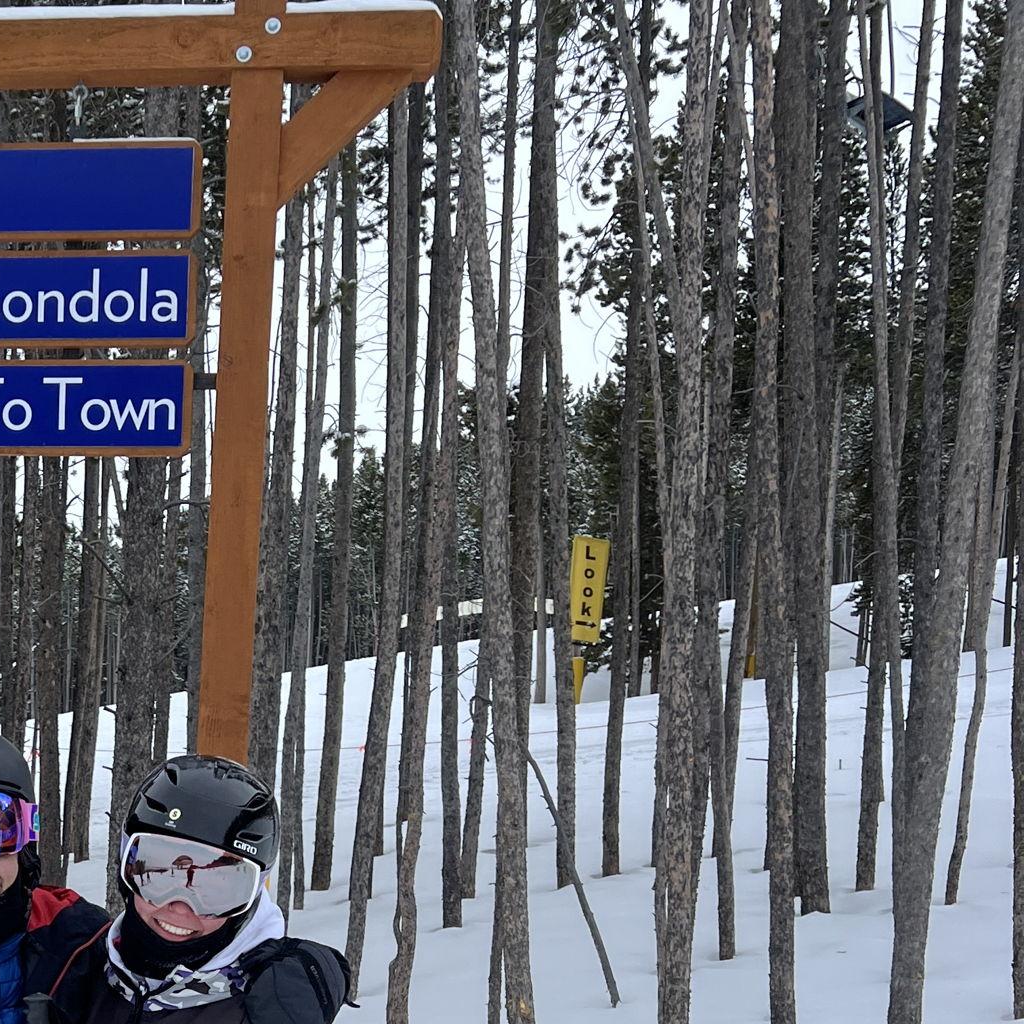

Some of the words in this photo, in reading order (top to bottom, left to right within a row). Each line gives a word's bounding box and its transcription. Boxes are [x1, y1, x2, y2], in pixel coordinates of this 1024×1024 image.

[42, 377, 176, 431] Town
[580, 545, 596, 617] Look
[233, 839, 258, 855] GIRO
